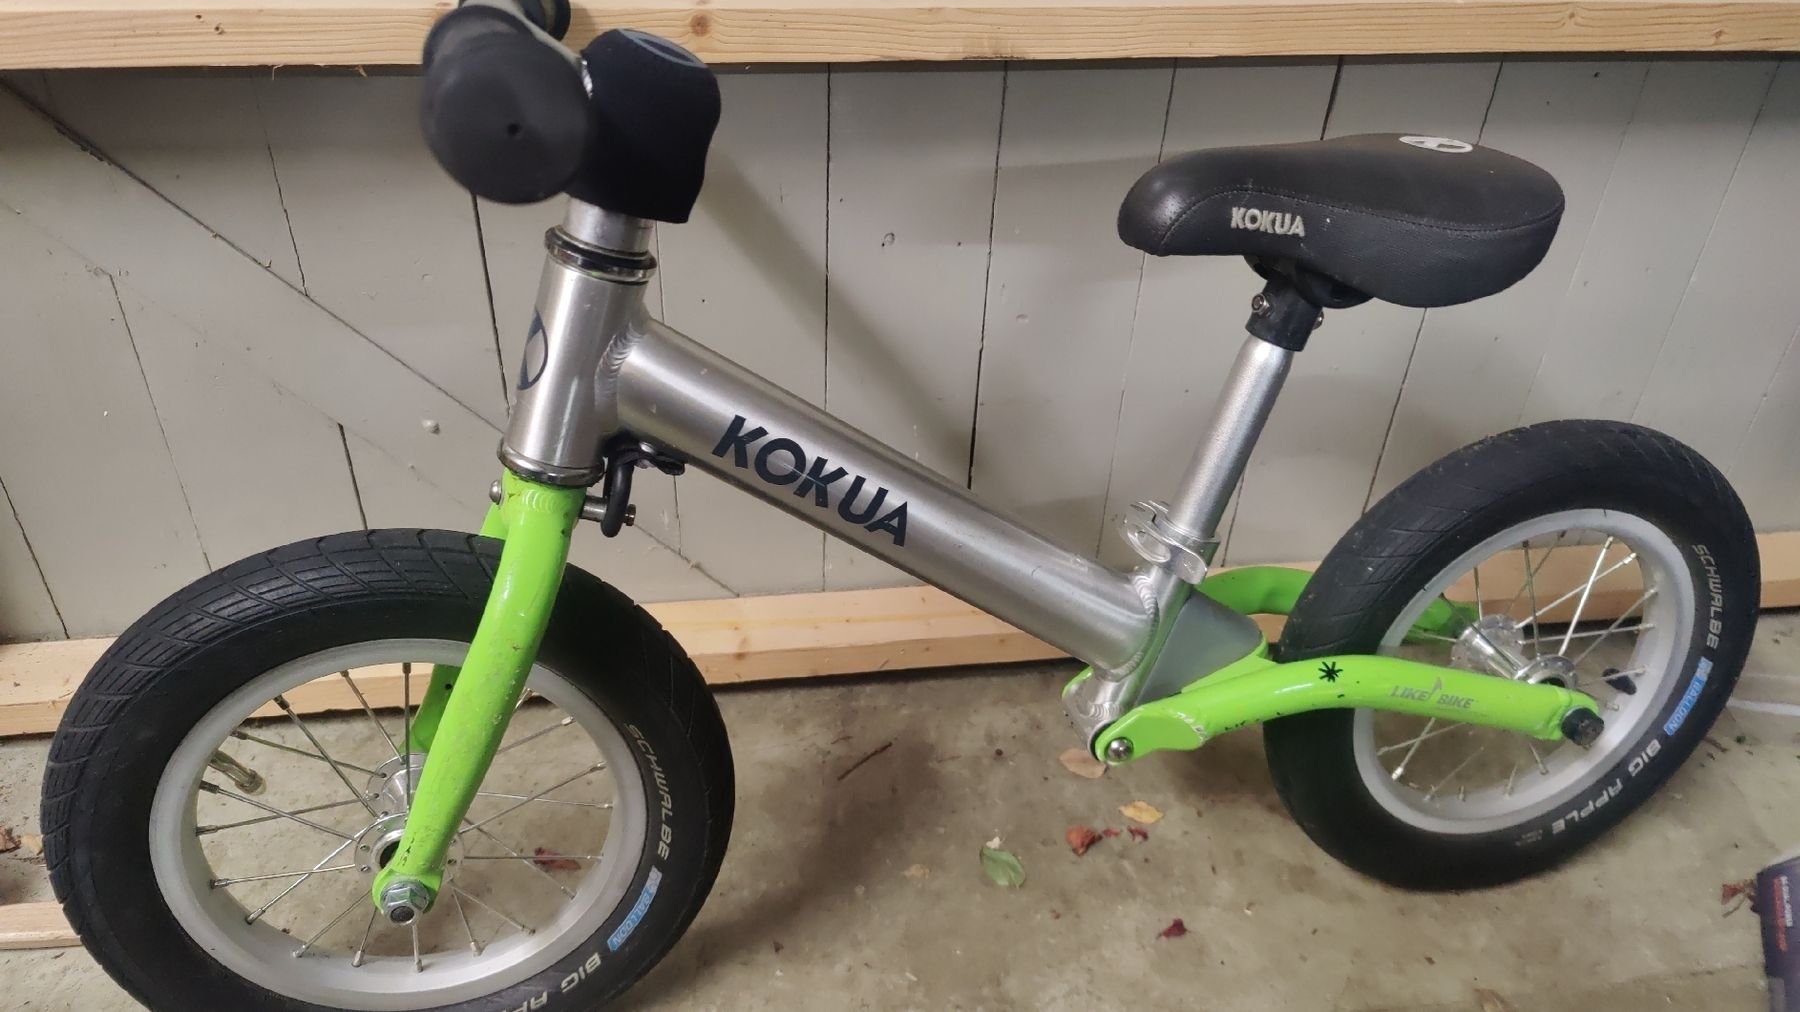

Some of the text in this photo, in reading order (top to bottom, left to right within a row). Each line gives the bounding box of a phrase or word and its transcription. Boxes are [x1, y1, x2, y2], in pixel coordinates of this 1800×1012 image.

[1231, 207, 1305, 237] KOKUA
[711, 414, 909, 547] KOKUA
[1692, 544, 1724, 650] SCHWALBE
[1390, 684, 1475, 709] LIKE BIKE
[1628, 739, 1661, 777] BIG
[624, 723, 673, 861] SCHWALBE
[1552, 778, 1624, 835] APPLE
[611, 888, 652, 947] BALLOON
[561, 952, 601, 993] BIG
